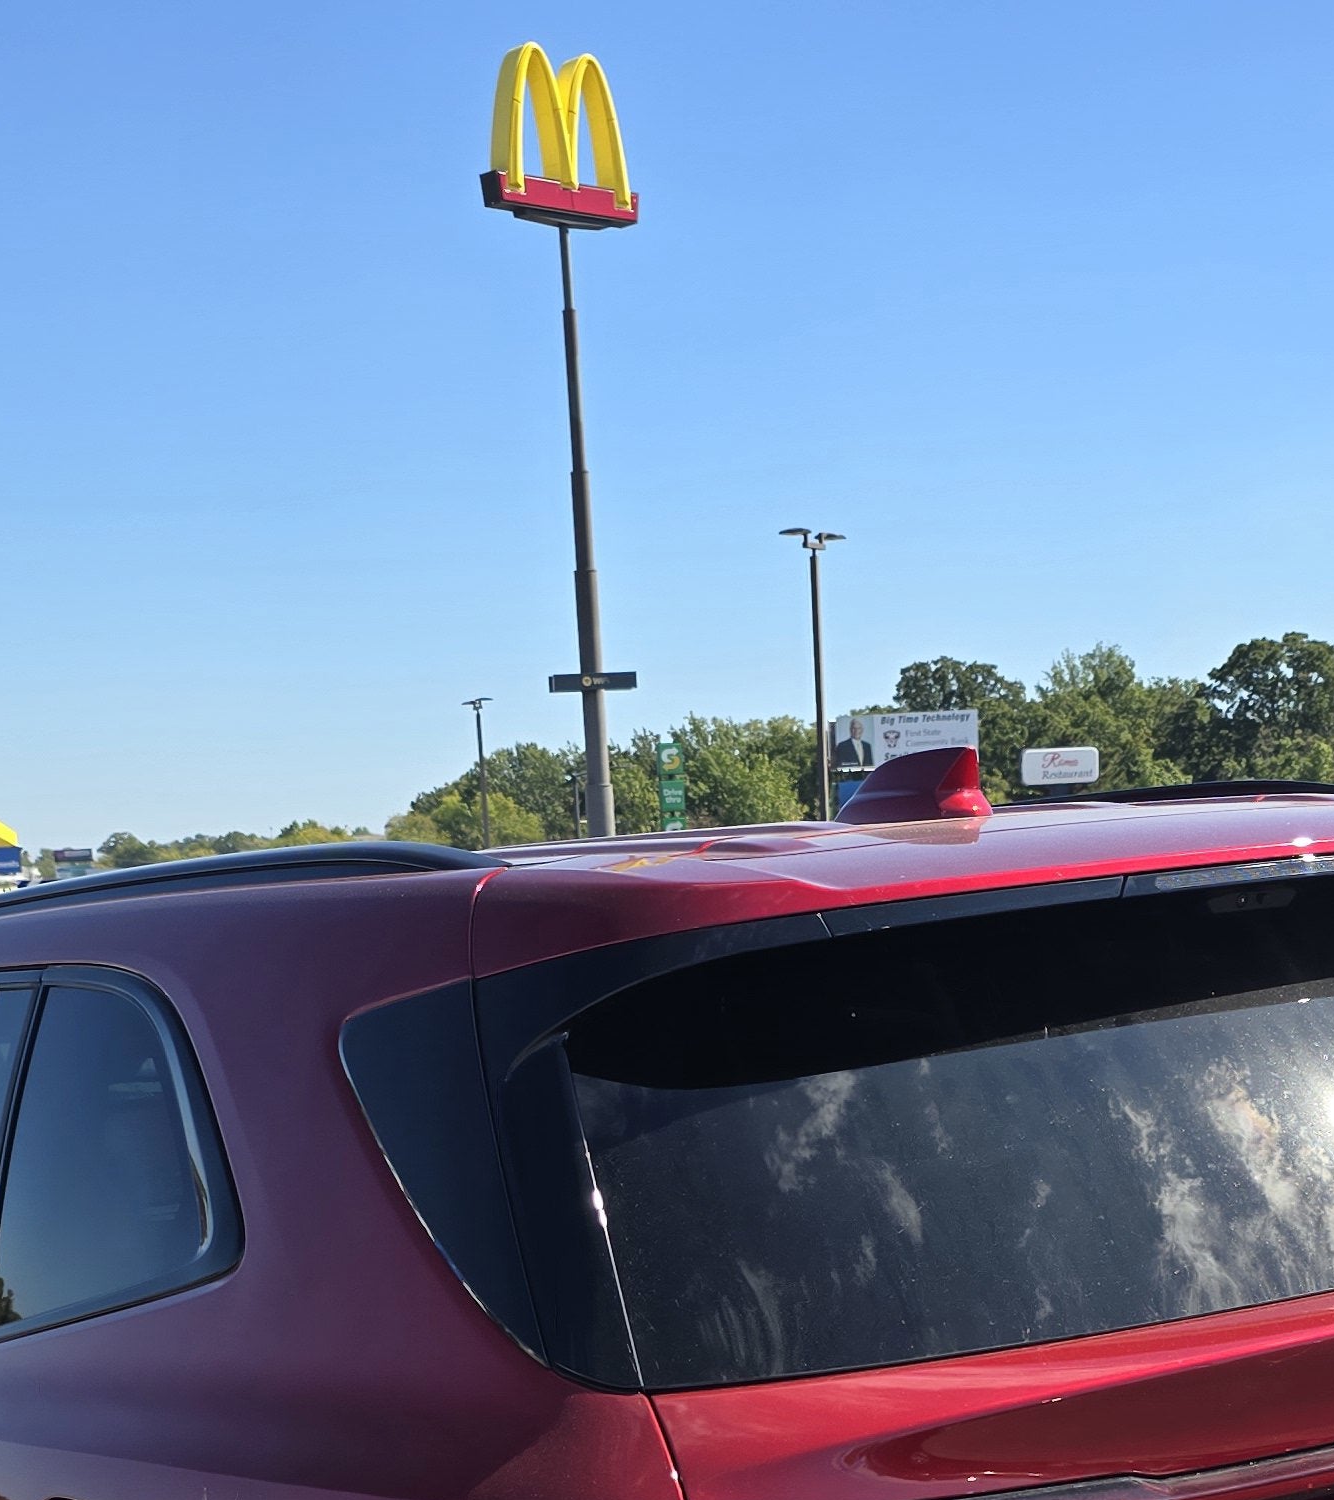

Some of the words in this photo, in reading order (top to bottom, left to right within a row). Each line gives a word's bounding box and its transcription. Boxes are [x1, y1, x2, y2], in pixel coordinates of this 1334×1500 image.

[881, 716, 895, 726] Big
[898, 715, 919, 724] Time
[922, 712, 970, 723] Technology
[1042, 769, 1093, 779] Restaurant
